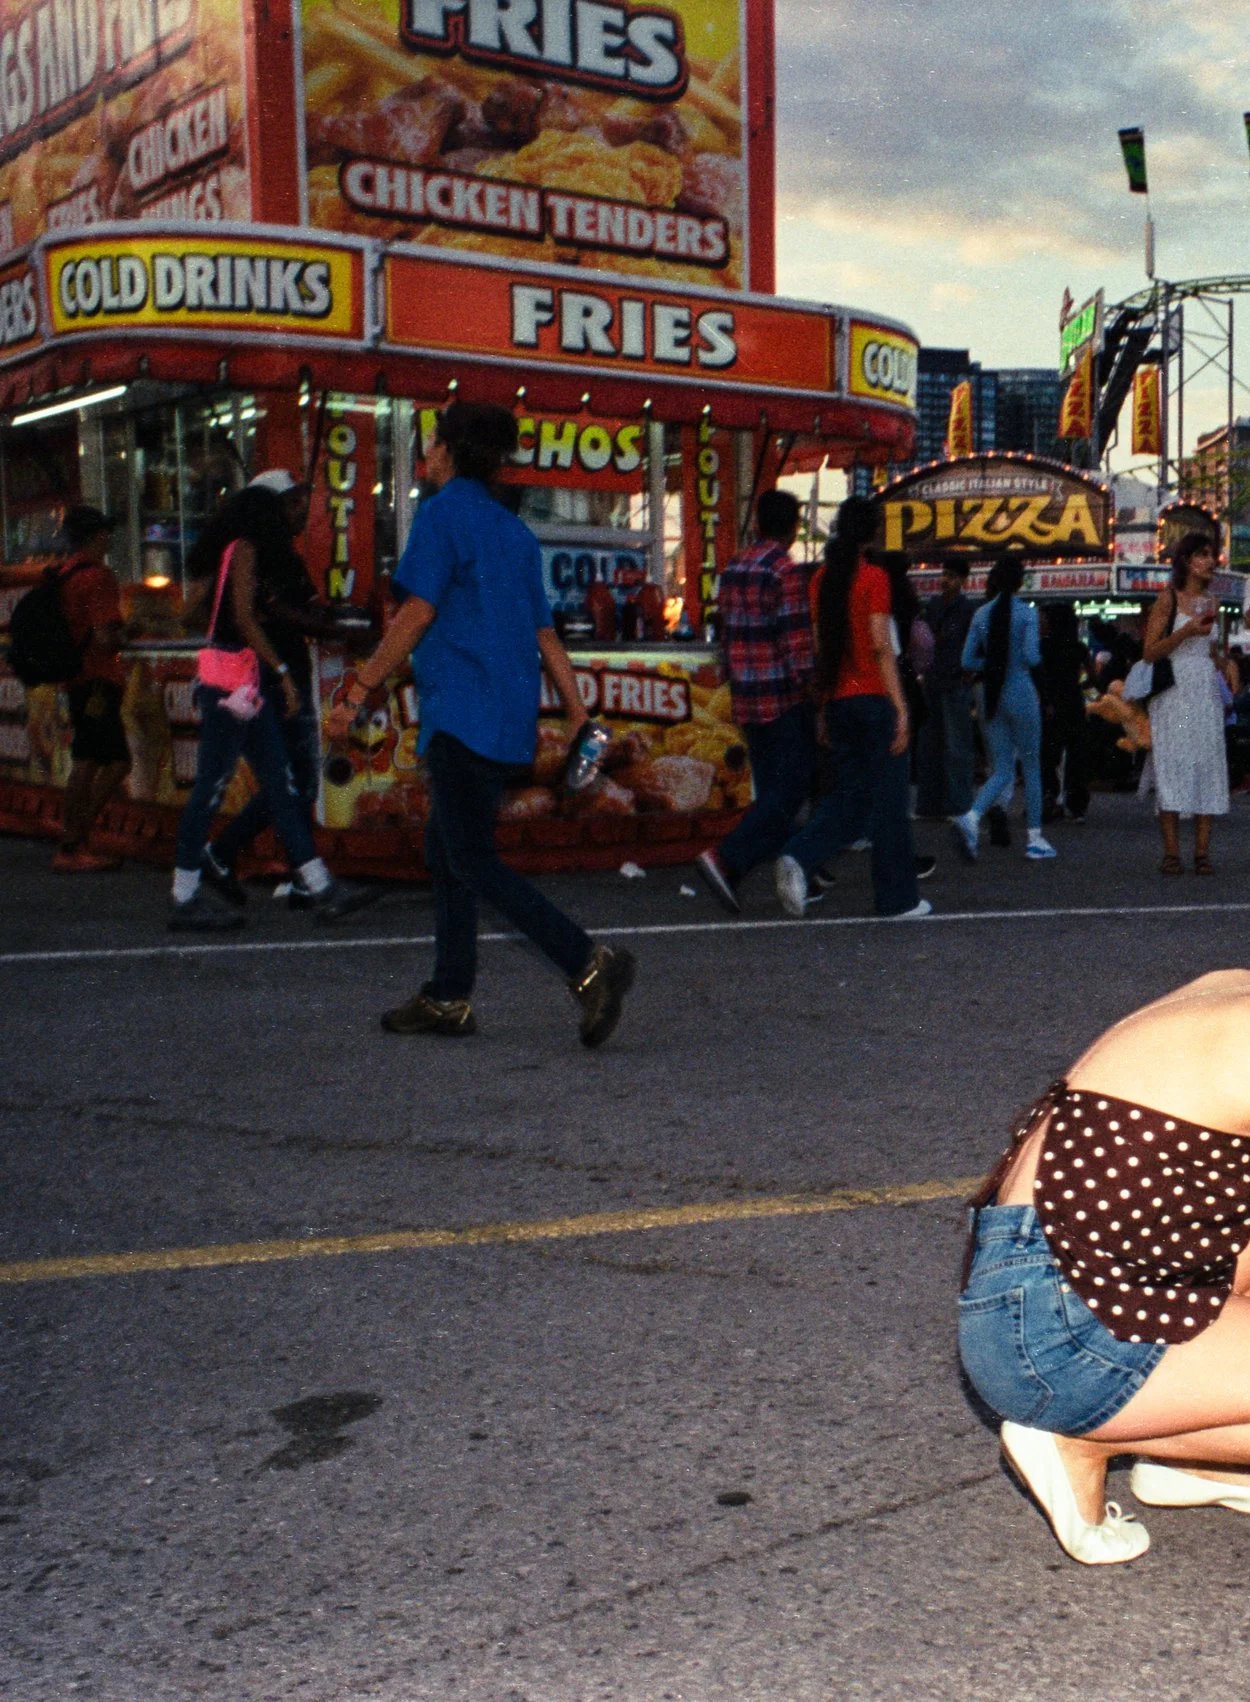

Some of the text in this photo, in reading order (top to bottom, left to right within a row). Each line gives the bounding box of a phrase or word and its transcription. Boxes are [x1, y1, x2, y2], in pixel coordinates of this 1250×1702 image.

[128, 90, 228, 190] CHICKEN
[140, 172, 223, 222] NGS
[345, 162, 728, 263] CHICKEN TENDERS
[60, 256, 332, 317] COLD DRINKS
[509, 285, 738, 369] FRIES
[418, 410, 642, 472] CHOS
[883, 494, 1101, 550] PIZZA
[604, 673, 689, 719] FRIES
